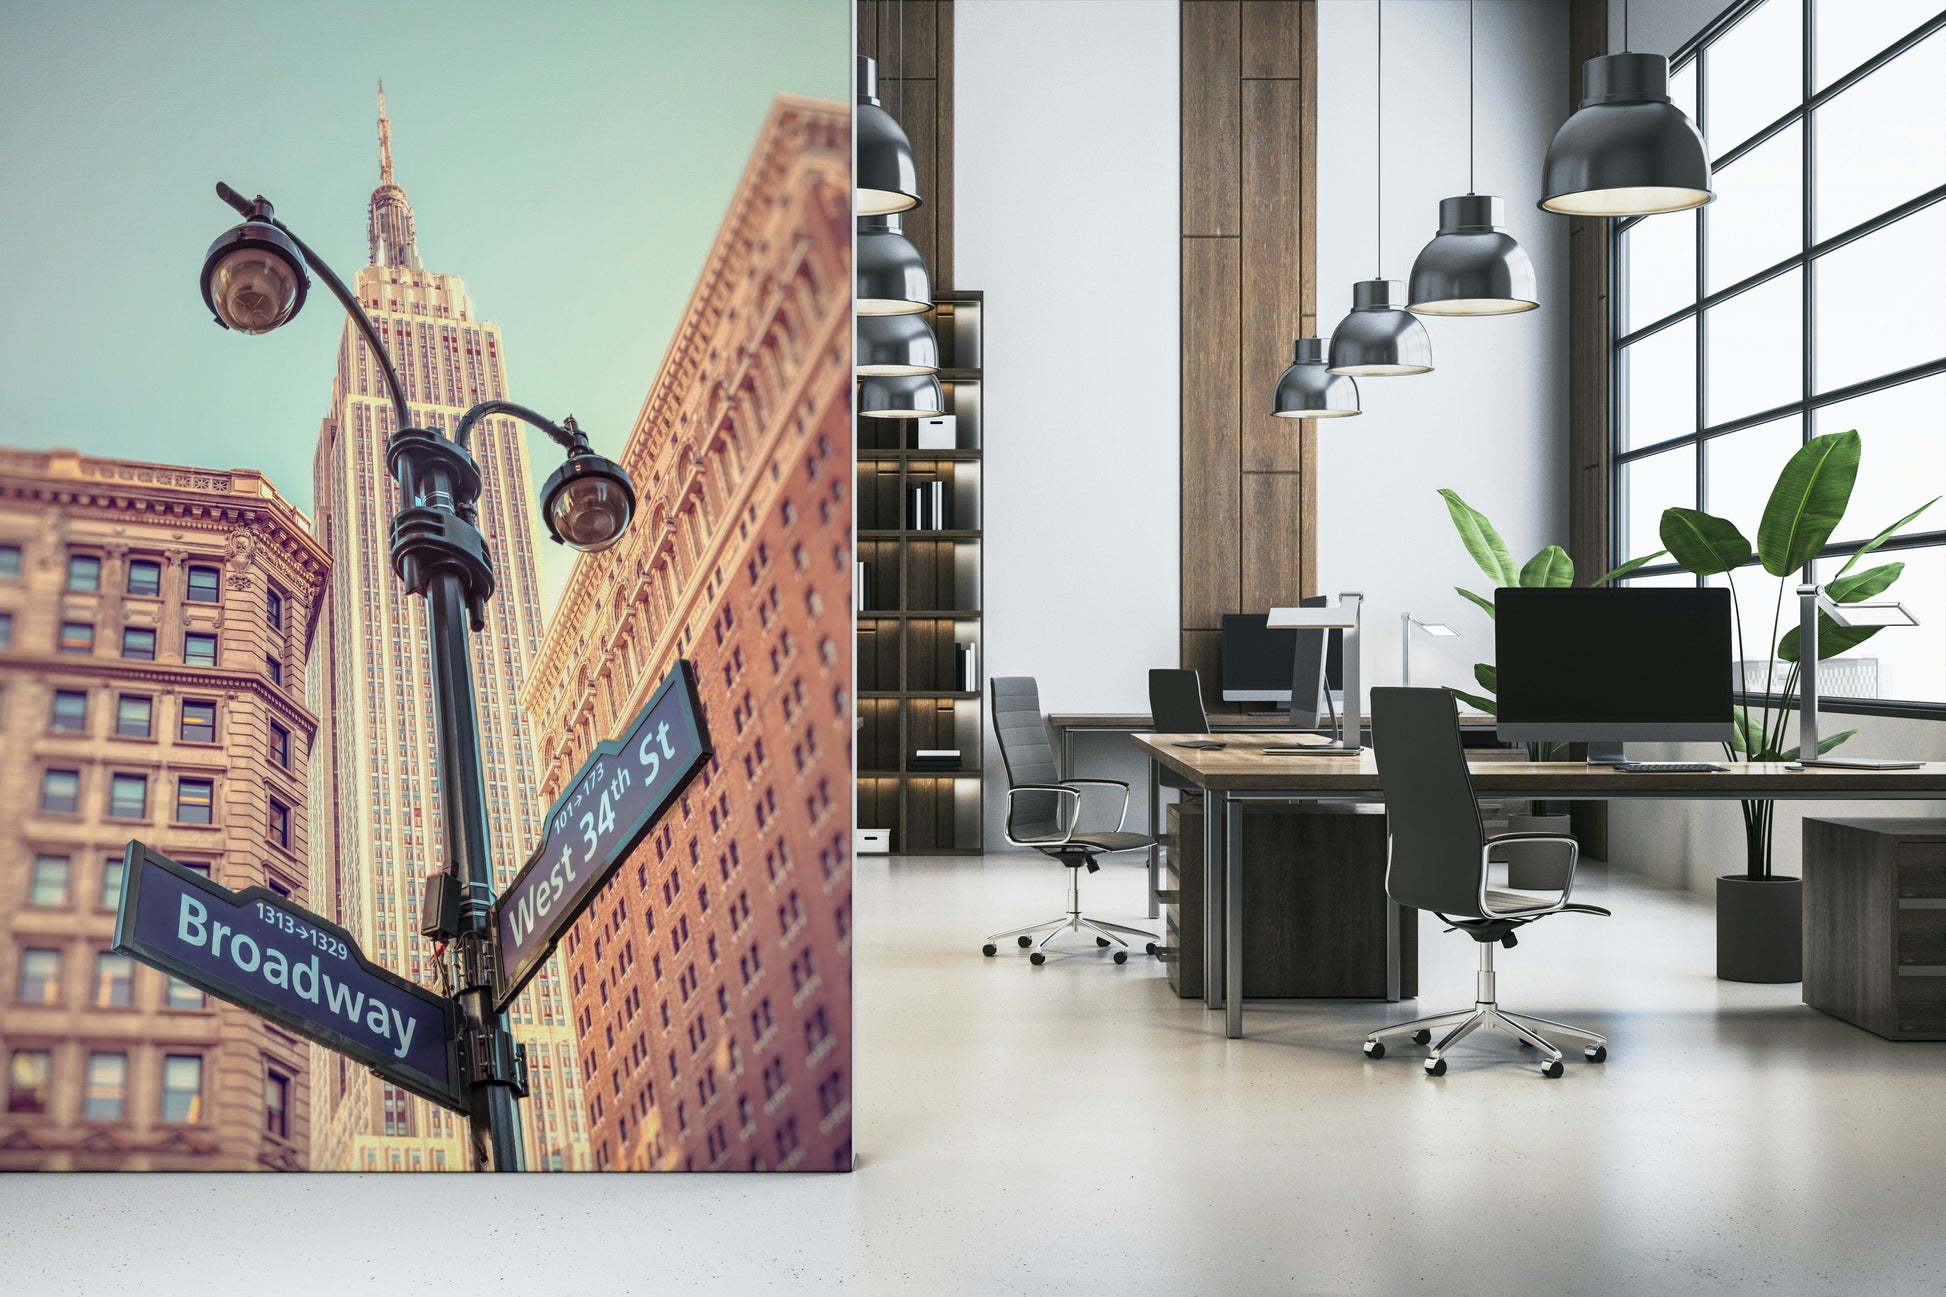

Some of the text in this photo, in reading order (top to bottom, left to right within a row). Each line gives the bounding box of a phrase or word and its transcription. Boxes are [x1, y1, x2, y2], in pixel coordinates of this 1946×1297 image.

[508, 719, 676, 949] West 34th St
[553, 762, 605, 835] 101 173
[177, 892, 416, 1058] Broadway
[256, 902, 348, 960] 1313 1329
